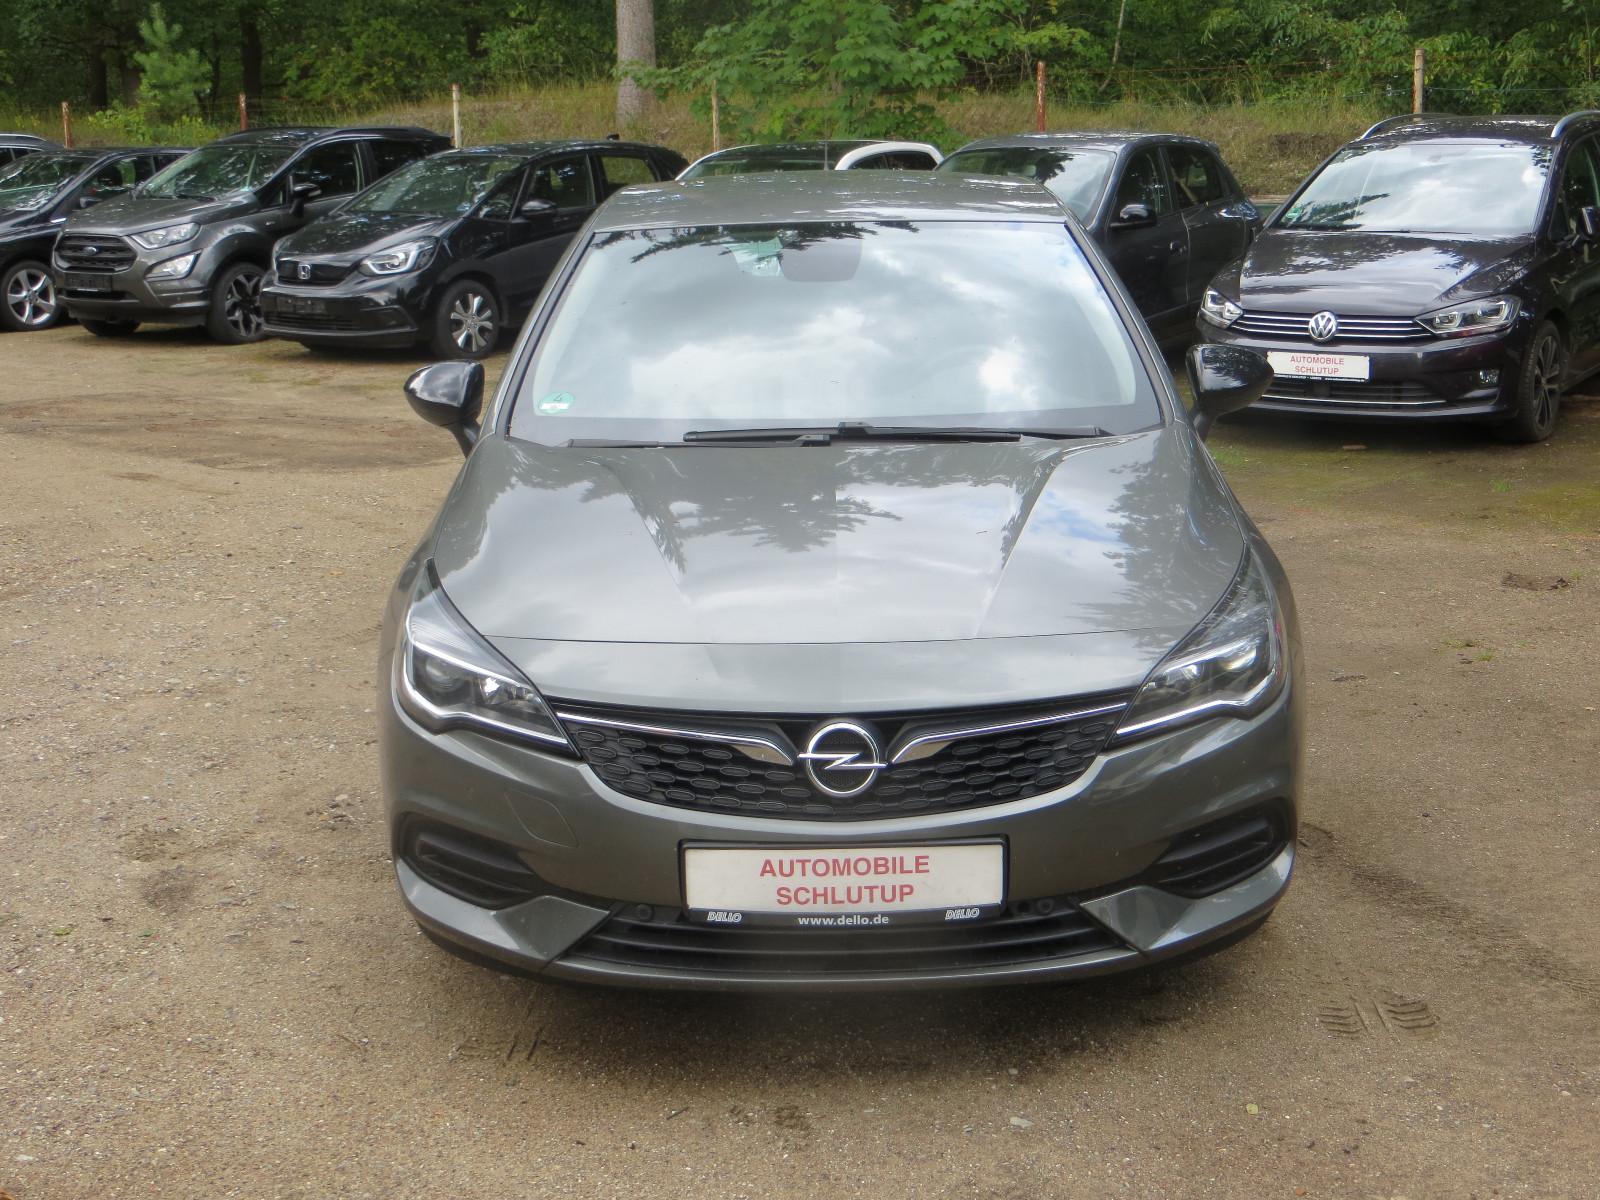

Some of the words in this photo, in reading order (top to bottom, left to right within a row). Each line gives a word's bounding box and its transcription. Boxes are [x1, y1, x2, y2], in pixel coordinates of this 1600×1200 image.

[1290, 355, 1344, 366] AUTOMOBILE
[1295, 366, 1339, 375] SCHLUTUP
[759, 855, 930, 878] AUTOMOBILE
[776, 884, 914, 906] SCHLUTUP
[707, 911, 743, 923] DELLO
[945, 907, 980, 920] DELLO
[798, 914, 889, 926] www.dello.de
